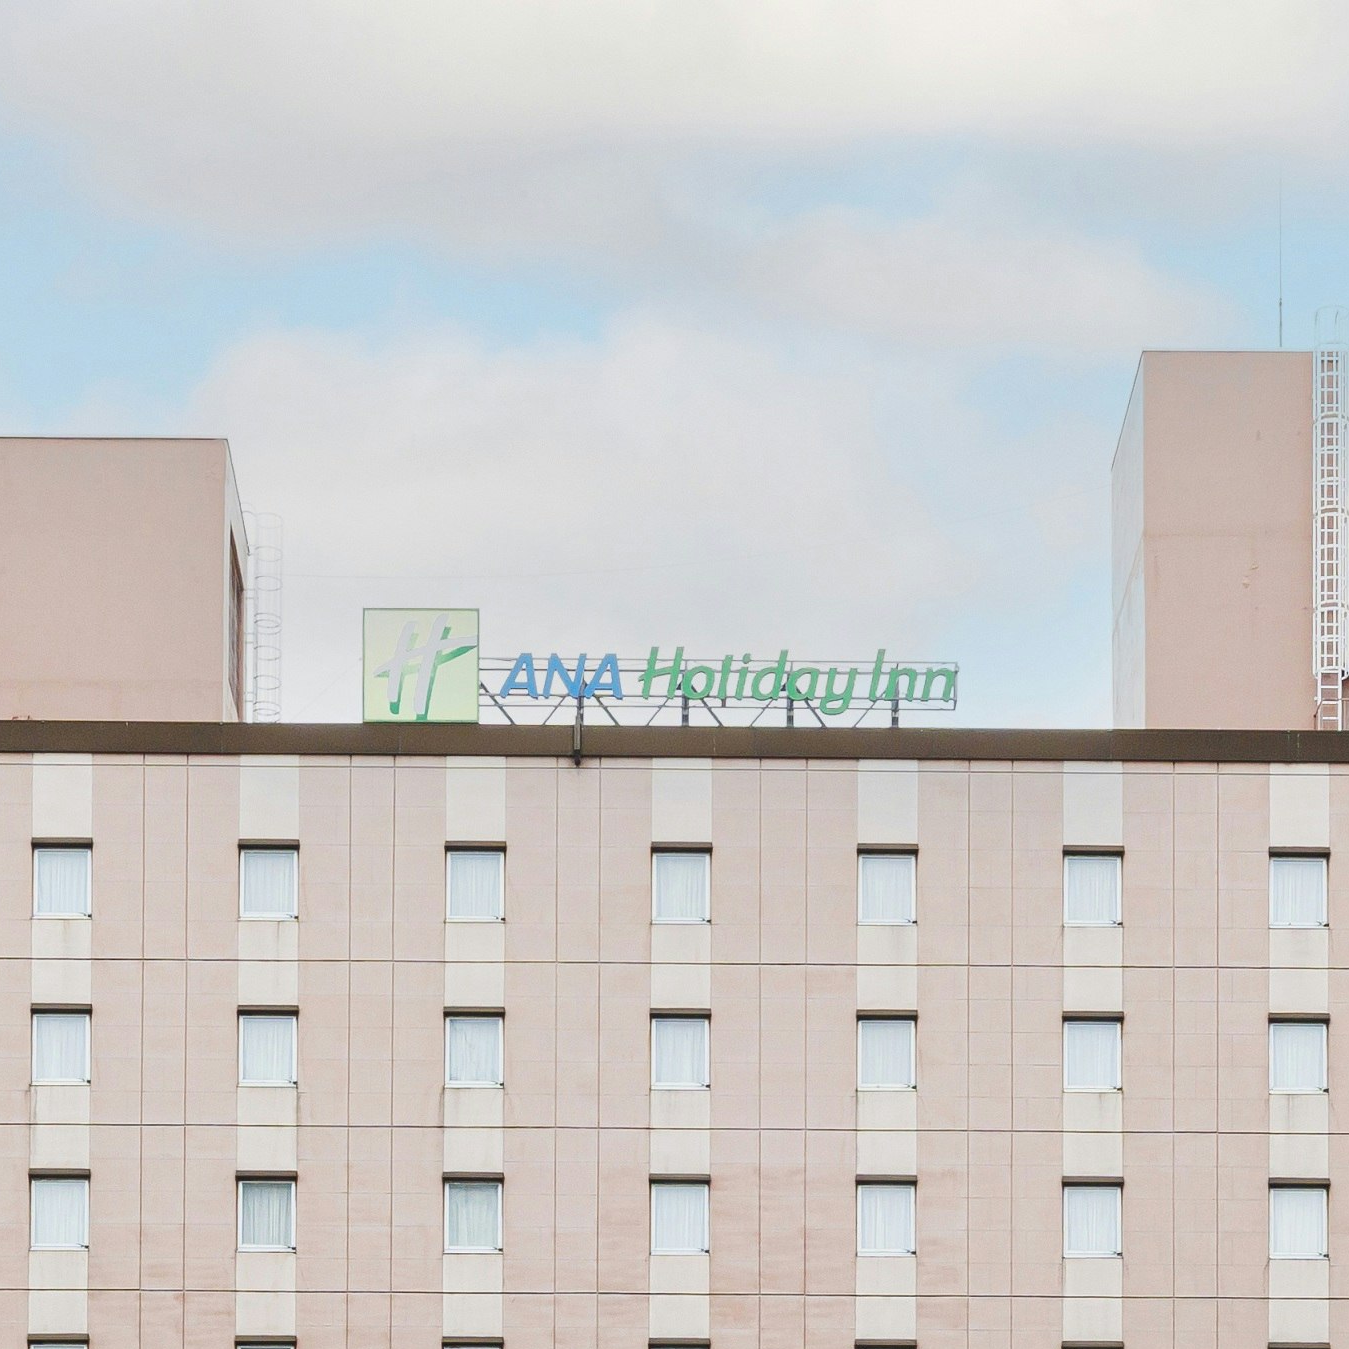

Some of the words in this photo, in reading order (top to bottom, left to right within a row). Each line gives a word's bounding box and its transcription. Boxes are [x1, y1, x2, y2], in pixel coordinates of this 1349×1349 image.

[500, 652, 623, 699] ANA
[639, 646, 857, 716] Holiday
[869, 649, 956, 702] Inn
